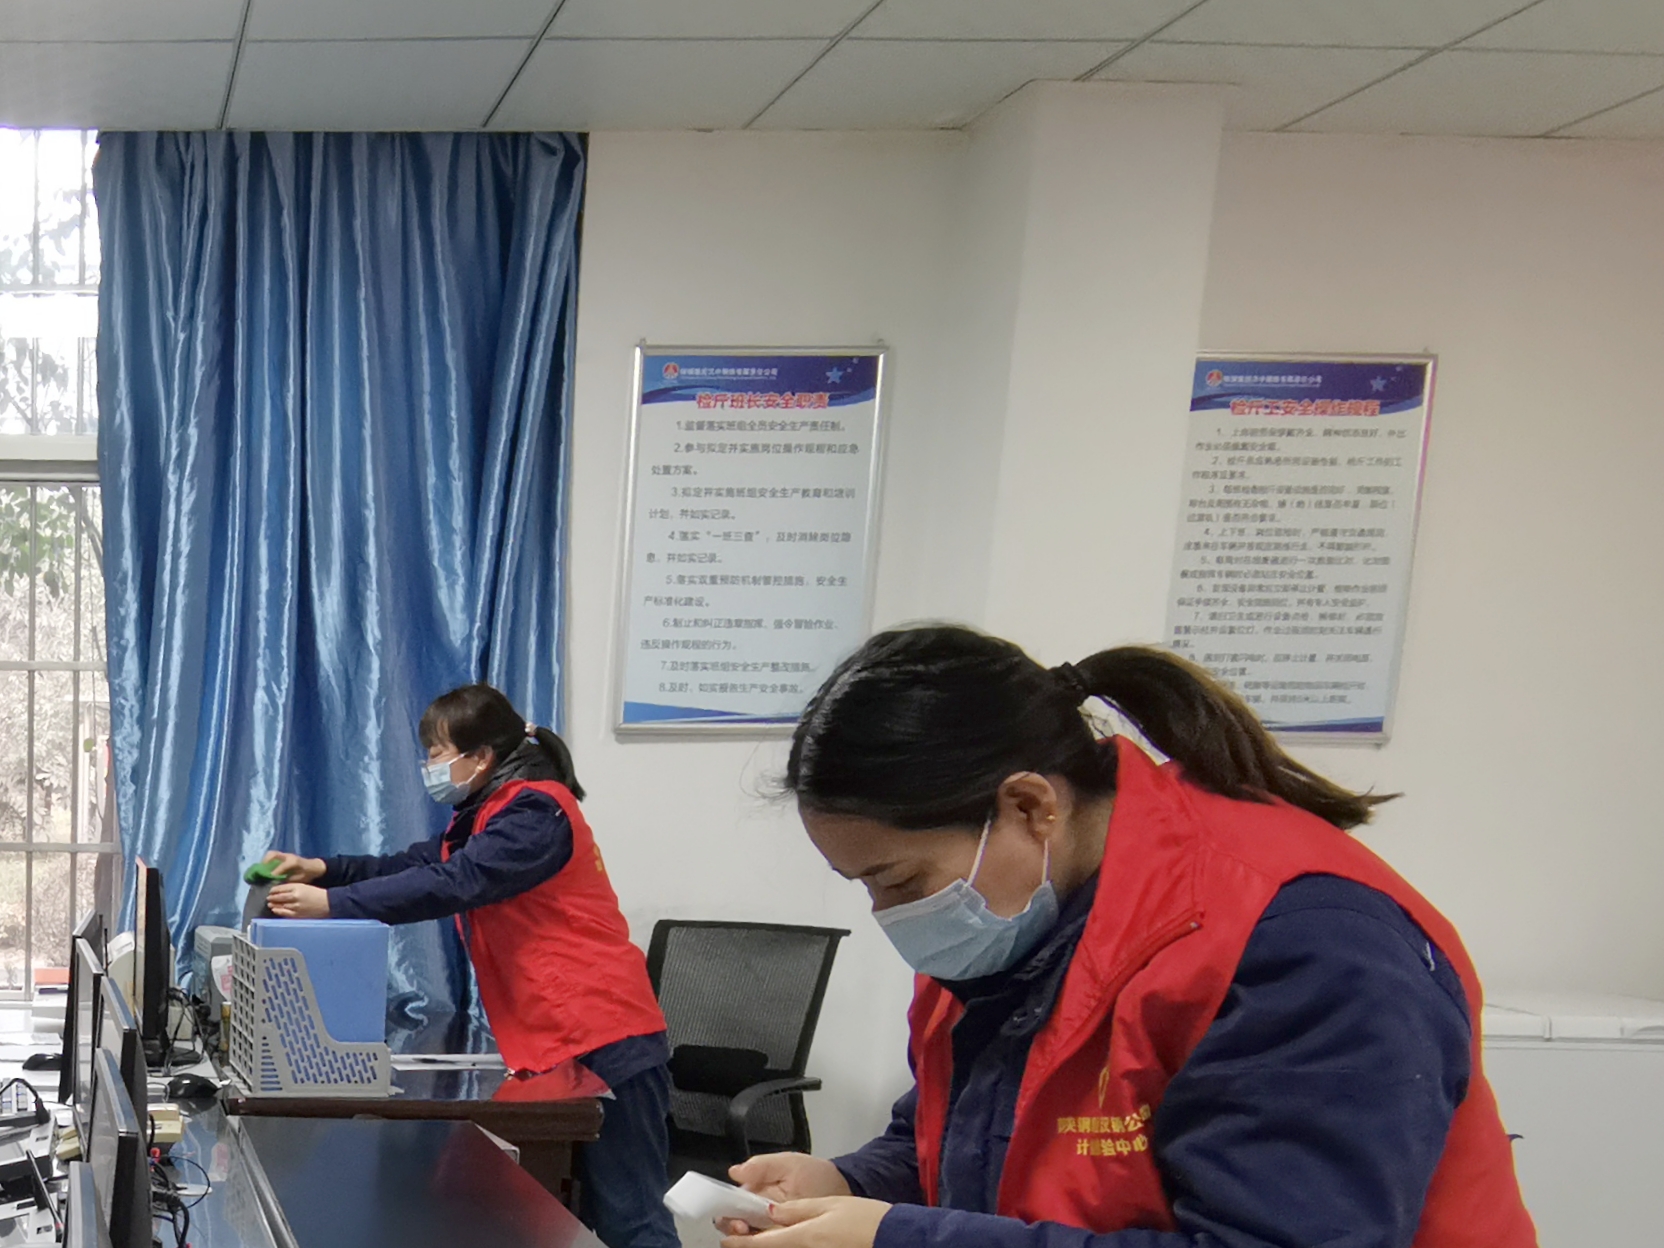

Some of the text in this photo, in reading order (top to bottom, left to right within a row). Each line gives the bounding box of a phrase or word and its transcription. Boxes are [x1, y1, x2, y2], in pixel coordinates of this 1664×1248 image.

[696, 392, 830, 410] 检斤班长安全职责
[651, 464, 699, 476] 处置方案。
